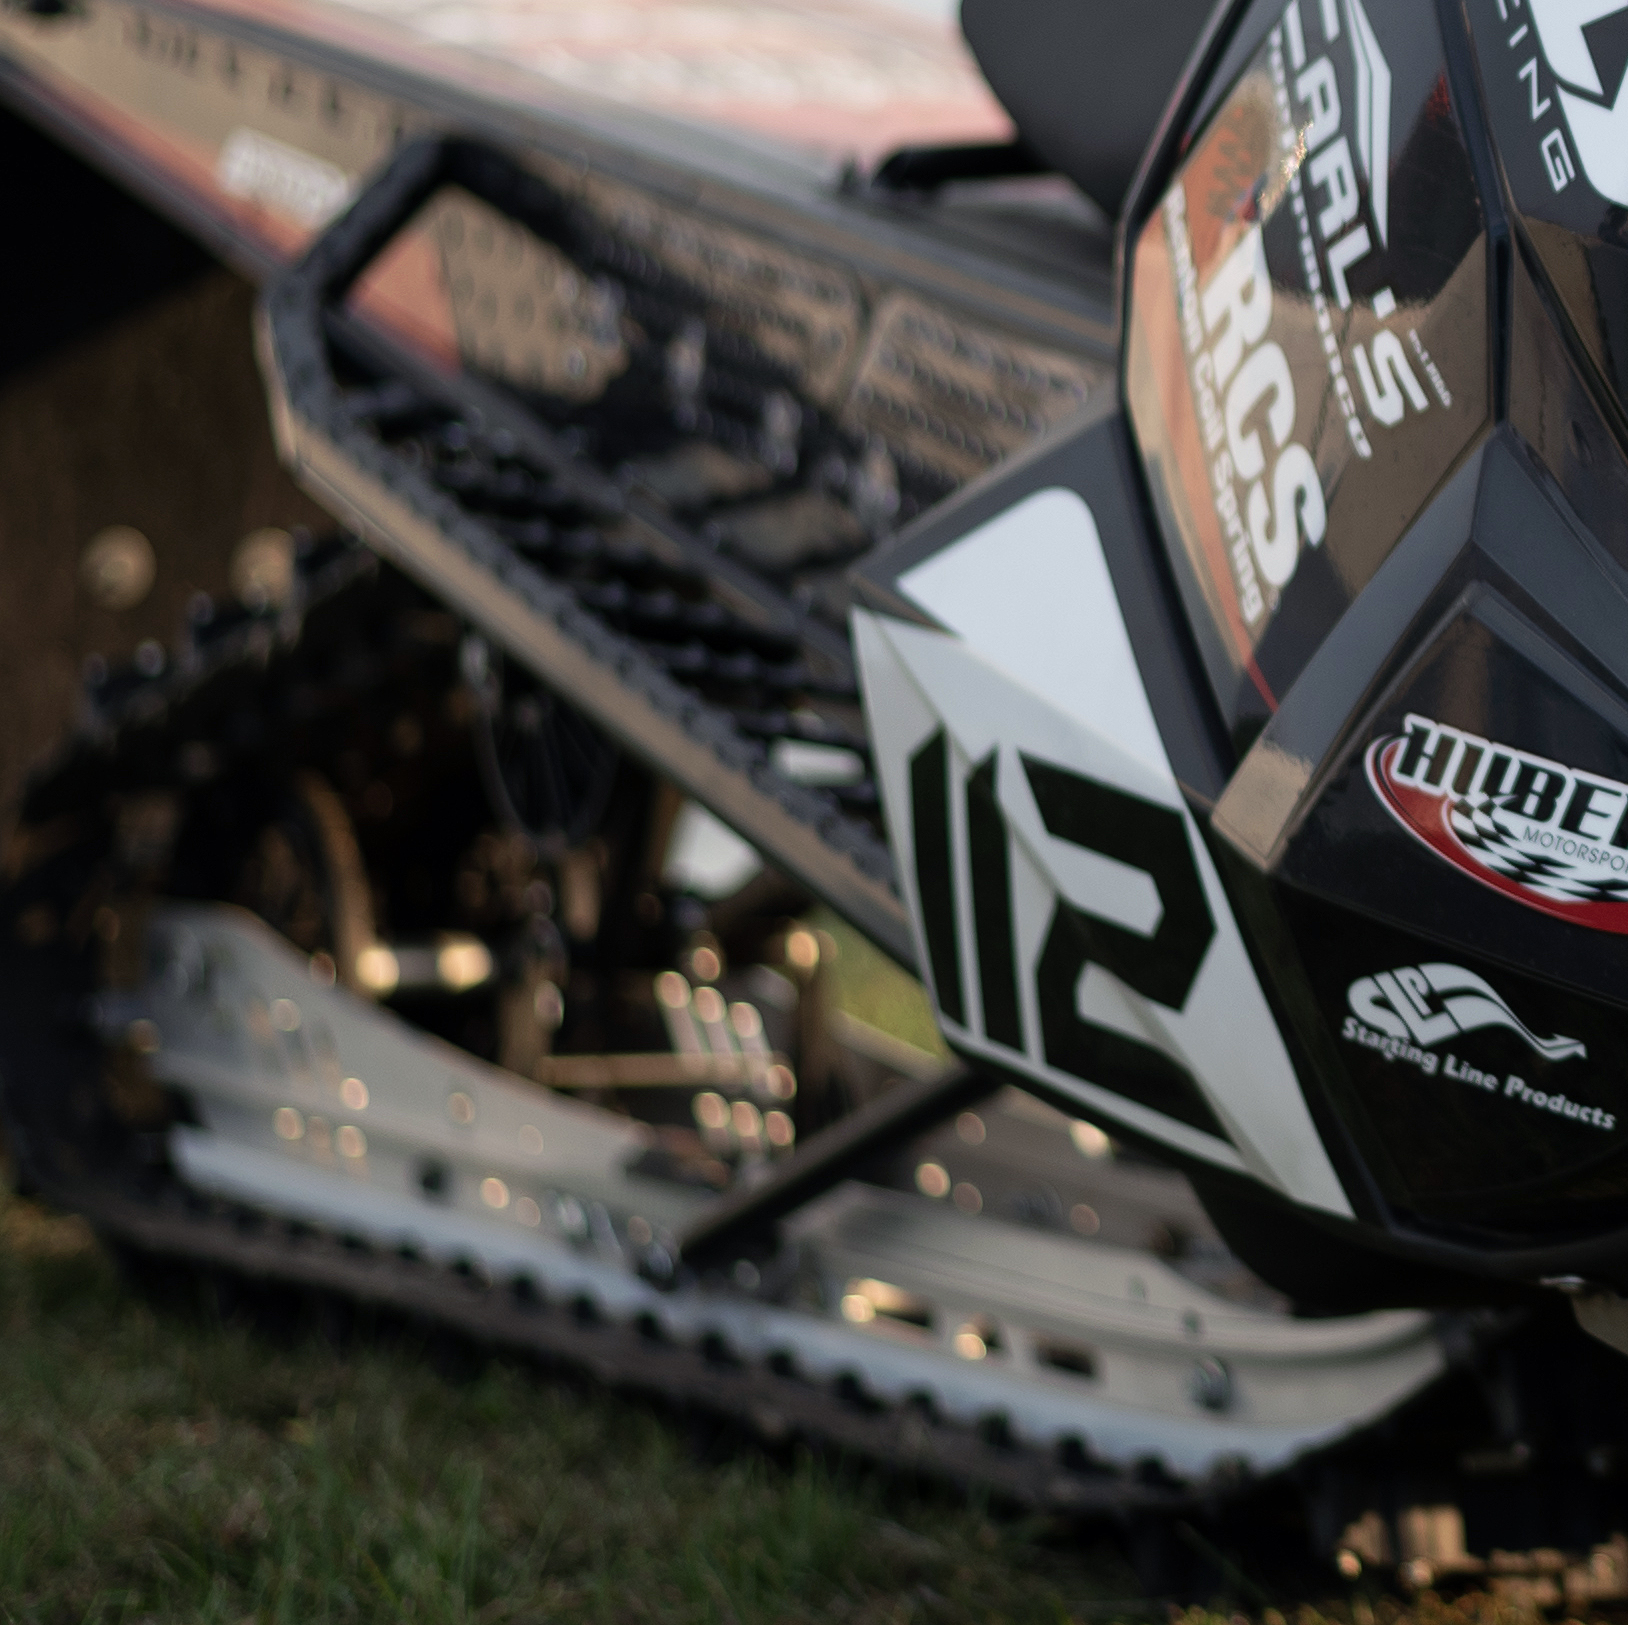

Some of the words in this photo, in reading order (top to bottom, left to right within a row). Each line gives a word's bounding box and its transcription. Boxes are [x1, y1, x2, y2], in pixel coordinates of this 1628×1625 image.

[1200, 218, 1328, 587] RCS
[1209, 456, 1267, 626] Spring
[1341, 1015, 1440, 1075] Starting
[1442, 1052, 1500, 1093] Line
[1502, 1073, 1617, 1132] Products
